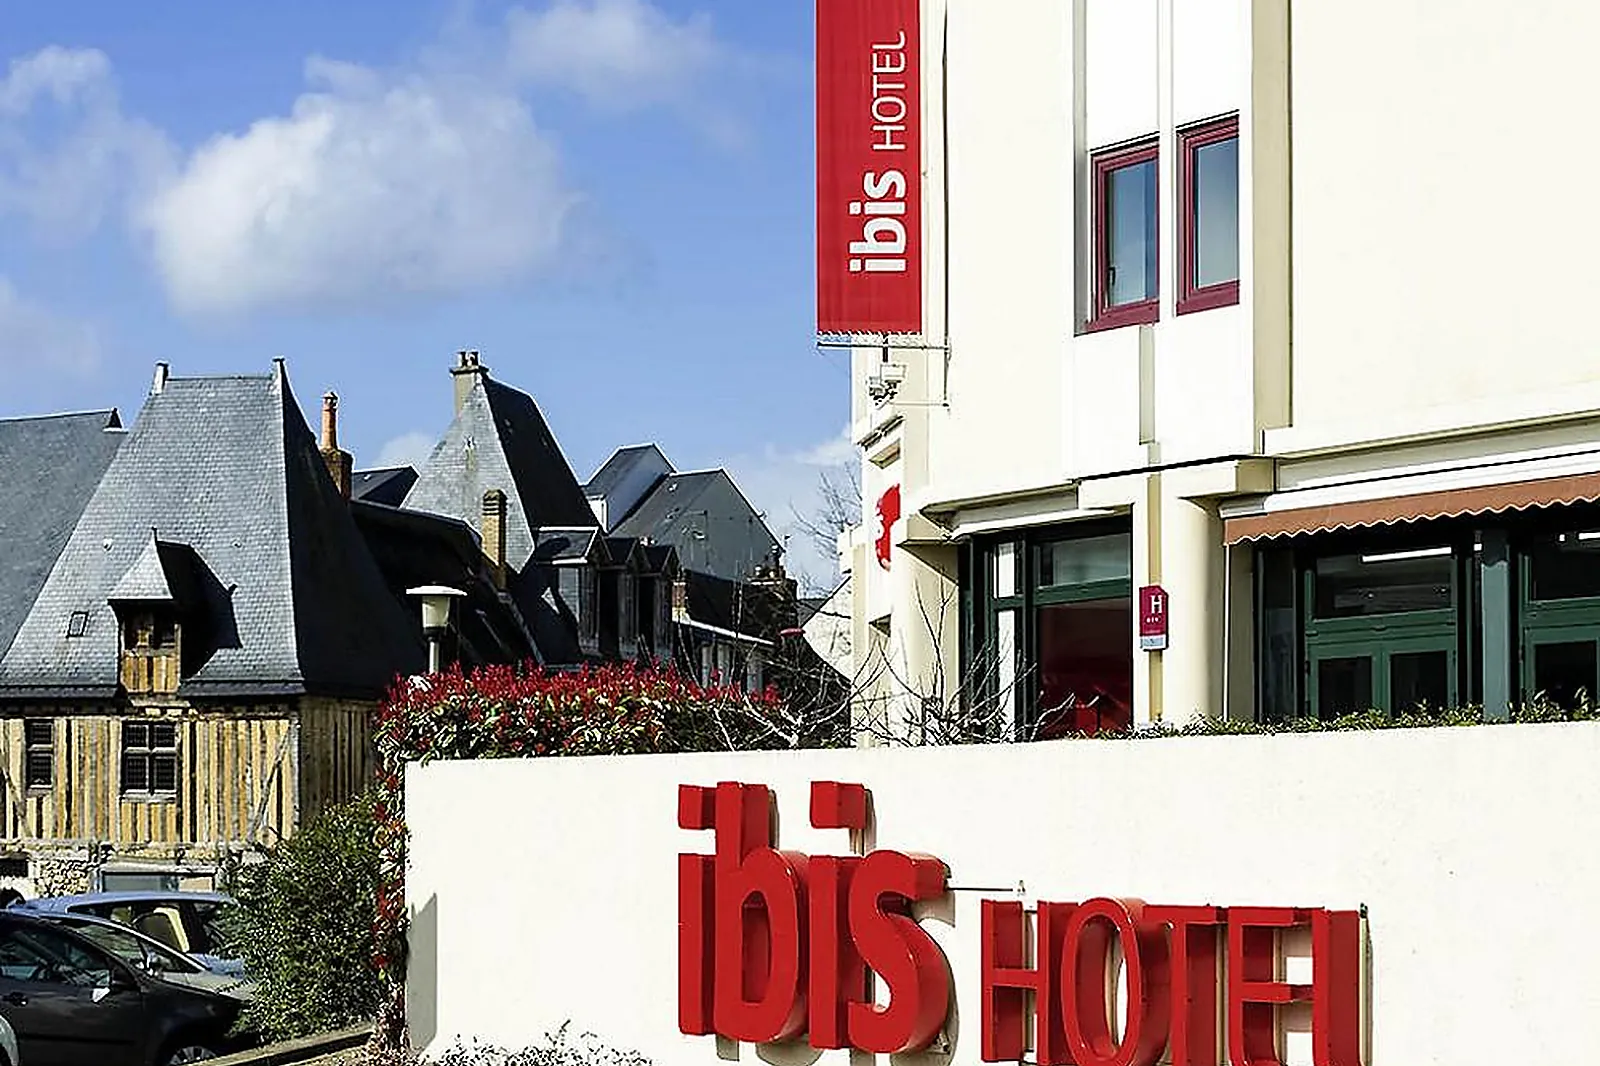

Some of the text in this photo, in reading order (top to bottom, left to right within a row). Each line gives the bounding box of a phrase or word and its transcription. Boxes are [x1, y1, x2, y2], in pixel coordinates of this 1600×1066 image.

[849, 31, 907, 273] ibis HOTEL
[1151, 595, 1163, 614] H
[678, 781, 1362, 1066] ibis HOTEL
